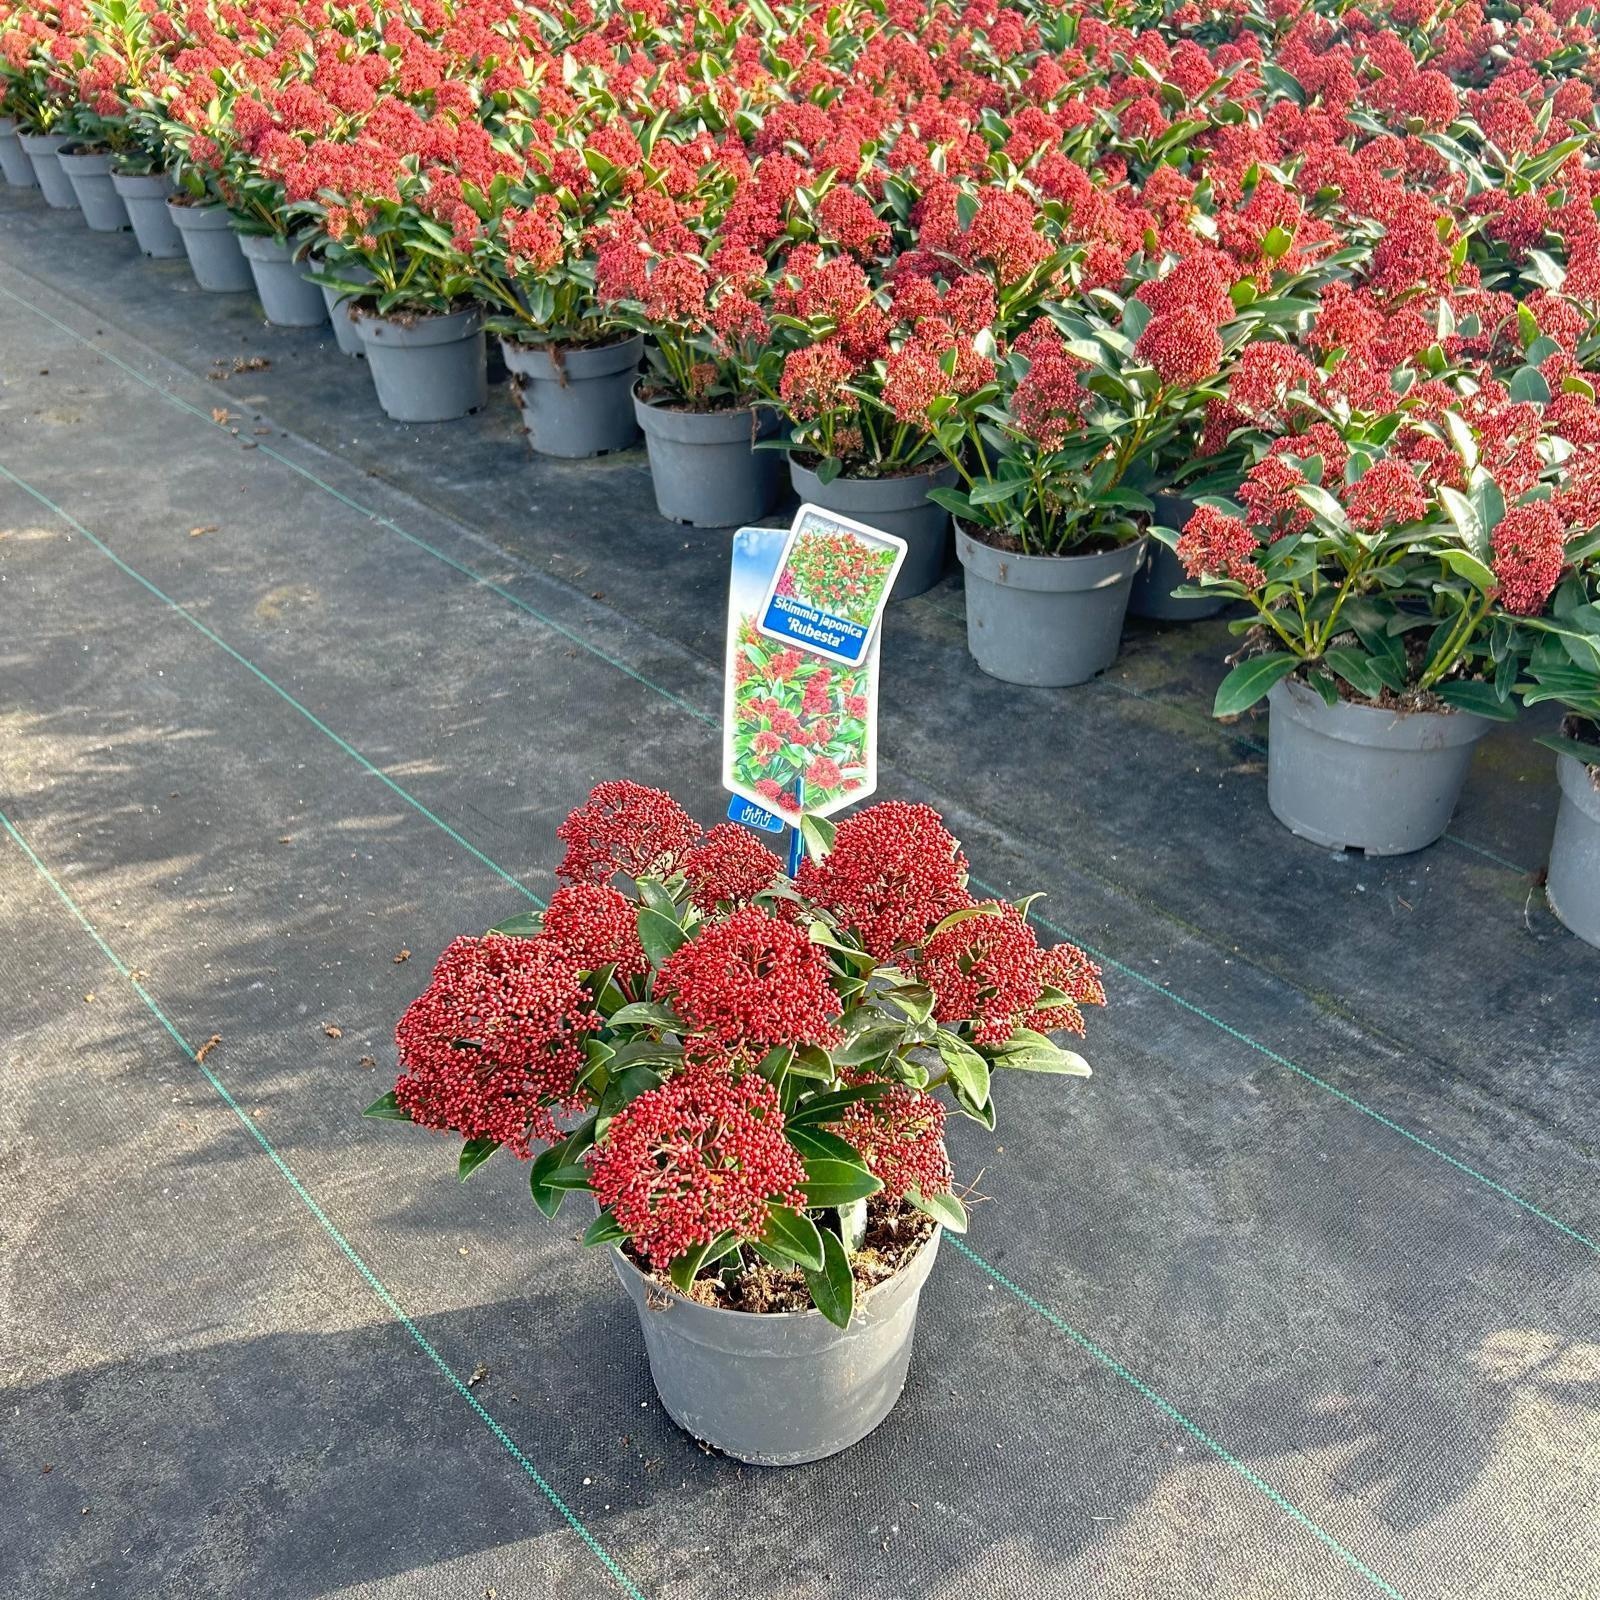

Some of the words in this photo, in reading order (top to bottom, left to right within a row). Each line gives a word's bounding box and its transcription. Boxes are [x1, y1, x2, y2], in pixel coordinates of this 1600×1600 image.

[774, 597, 819, 622] Skimmia
[818, 613, 863, 638] japonica
[787, 616, 845, 648] ‘Rubesta’
